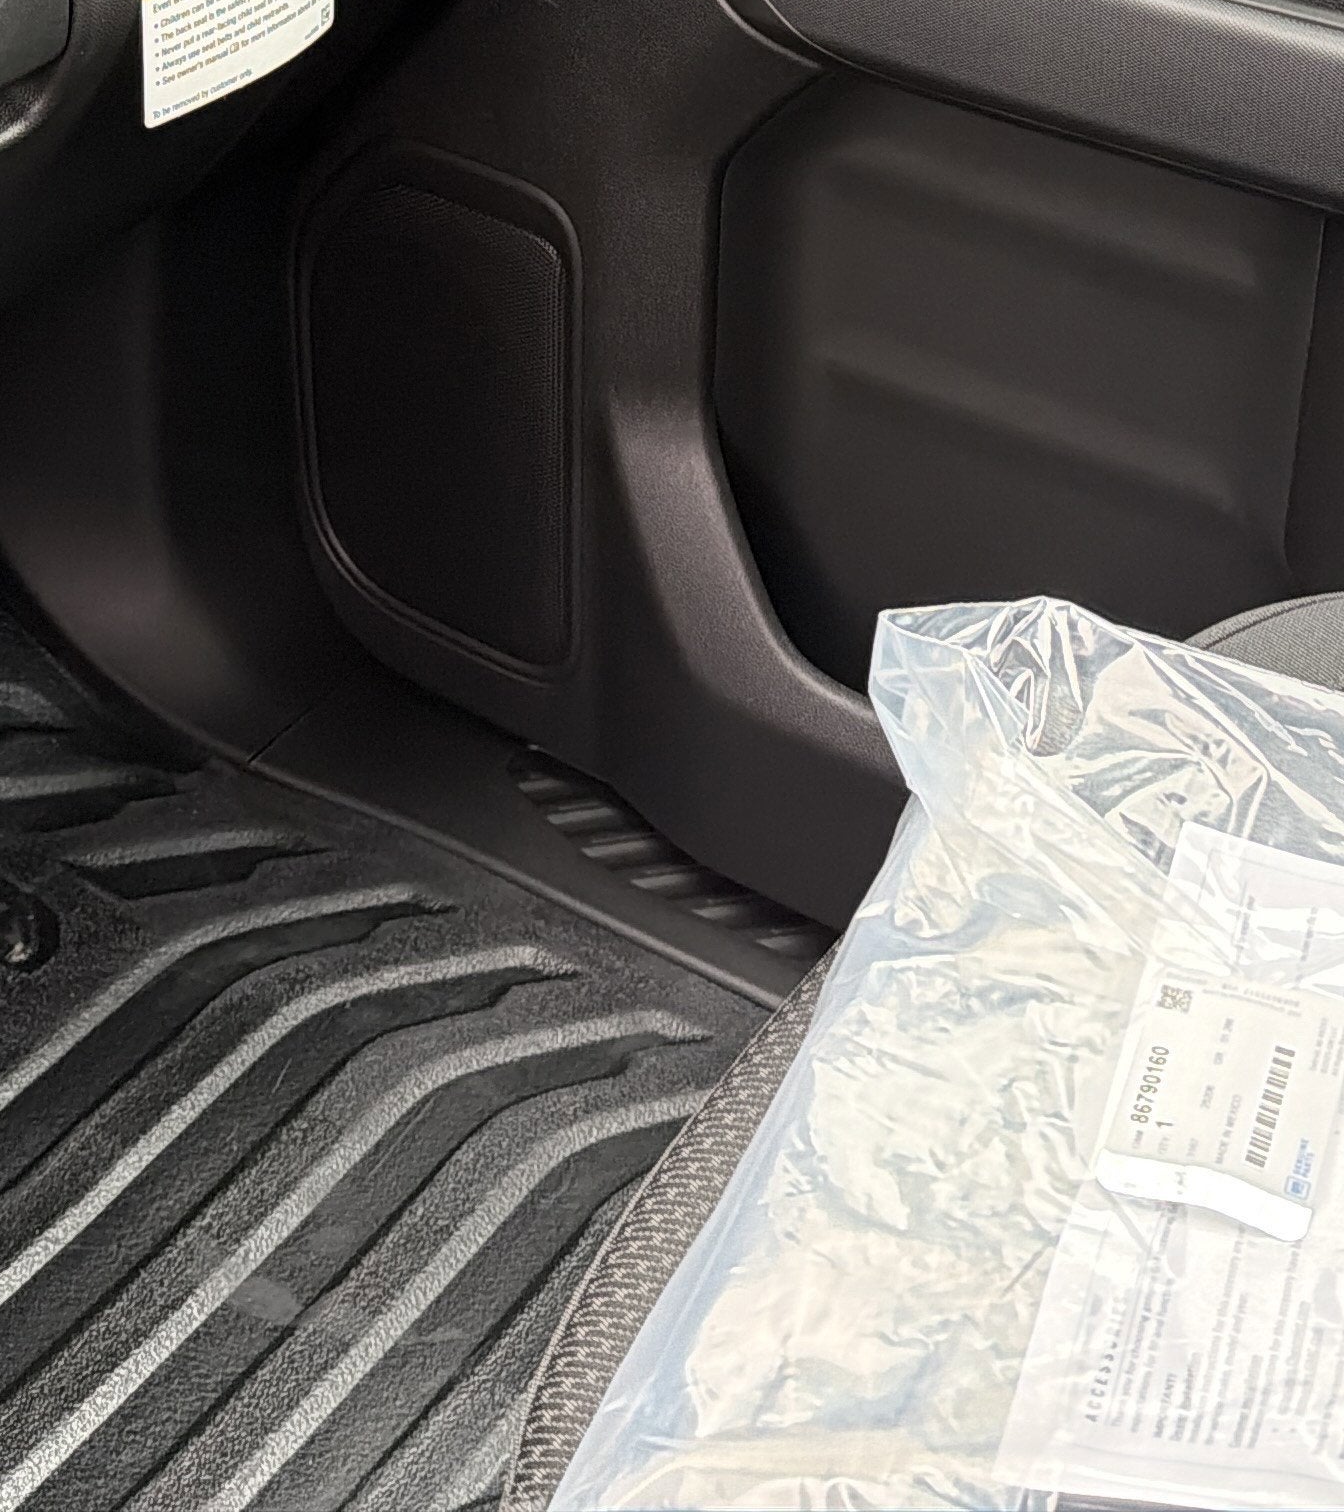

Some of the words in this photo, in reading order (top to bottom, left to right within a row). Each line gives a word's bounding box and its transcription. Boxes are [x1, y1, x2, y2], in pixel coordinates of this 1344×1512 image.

[153, 0, 171, 14] Even
[160, 9, 191, 28] Children
[192, 3, 204, 14] can
[161, 32, 174, 42] The
[176, 22, 192, 36] back
[216, 7, 226, 17] the
[162, 42, 182, 57] Never
[184, 35, 194, 49] put
[238, 7, 252, 21] child
[162, 55, 187, 71] Always
[202, 40, 216, 53] seat
[217, 33, 232, 46] belts
[234, 25, 245, 37] and
[247, 17, 261, 30] child
[162, 74, 175, 85] See
[205, 48, 228, 65] manual
[153, 111, 161, 119] To
[162, 107, 171, 116] be
[172, 92, 200, 111] removed
[201, 90, 208, 99] by
[210, 76, 238, 94] customer
[1130, 1045, 1170, 1124] 86790160
[1155, 1120, 1174, 1128] 1
[1226, 1094, 1242, 1128] MEXICO
[1222, 1129, 1234, 1139] IN
[1215, 1139, 1230, 1165] MADE
